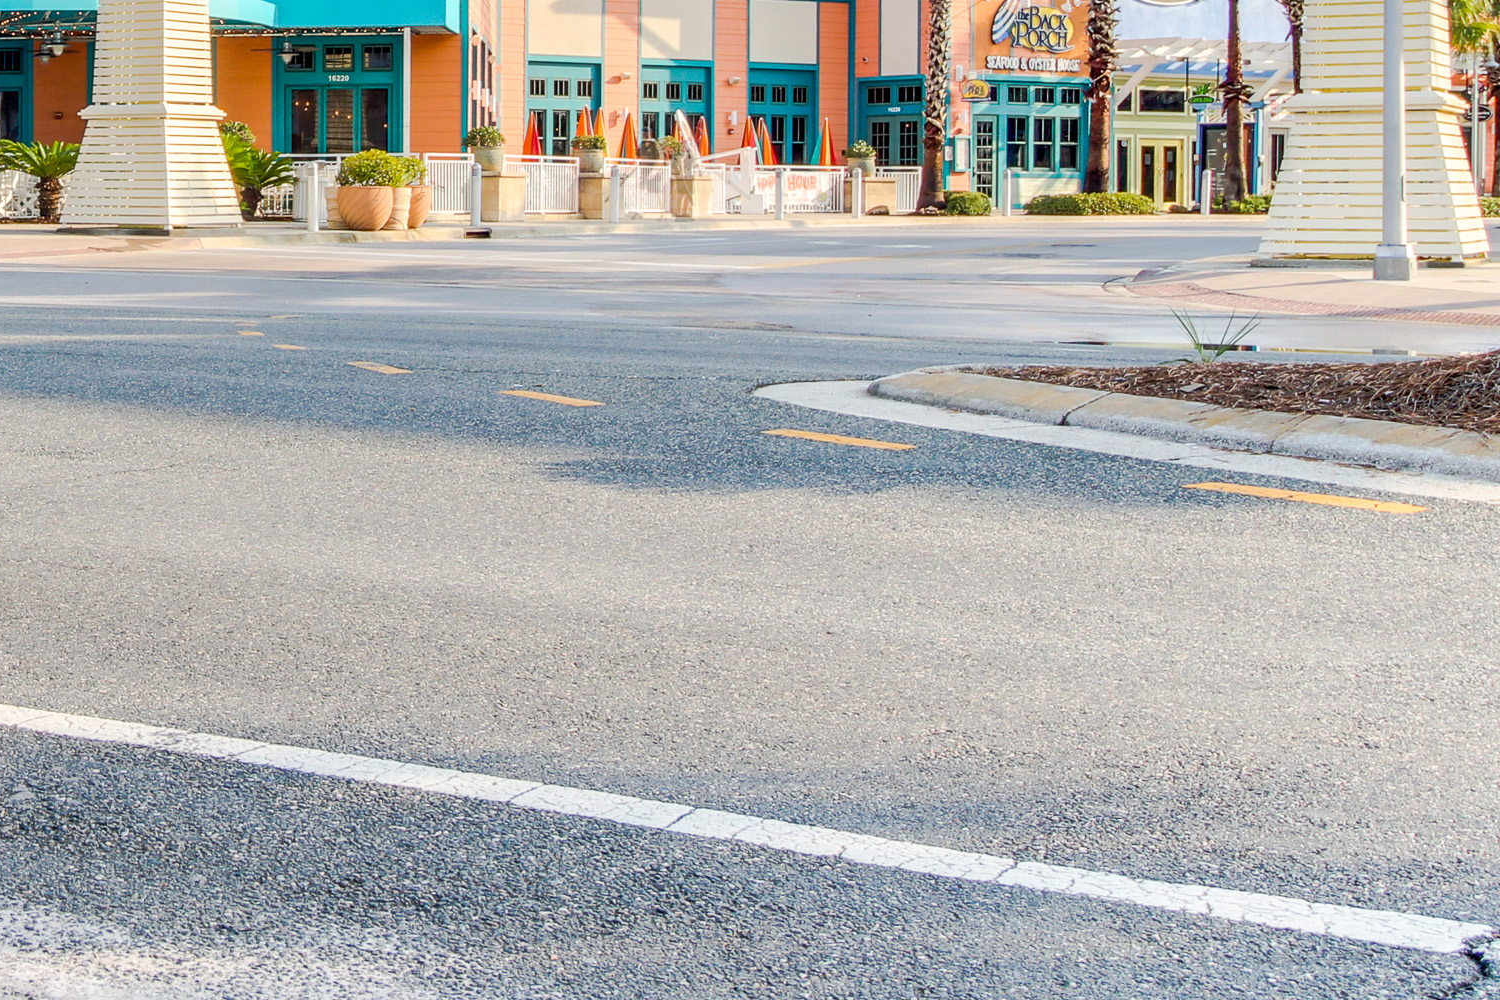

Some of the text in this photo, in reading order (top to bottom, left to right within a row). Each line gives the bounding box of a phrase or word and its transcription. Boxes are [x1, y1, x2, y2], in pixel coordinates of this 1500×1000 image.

[1017, 6, 1068, 31] the BACK
[1013, 20, 1074, 53] PORCH
[986, 56, 1080, 72] SEAFOOD & OYSTER HOUSE
[787, 174, 817, 191] HOUR
